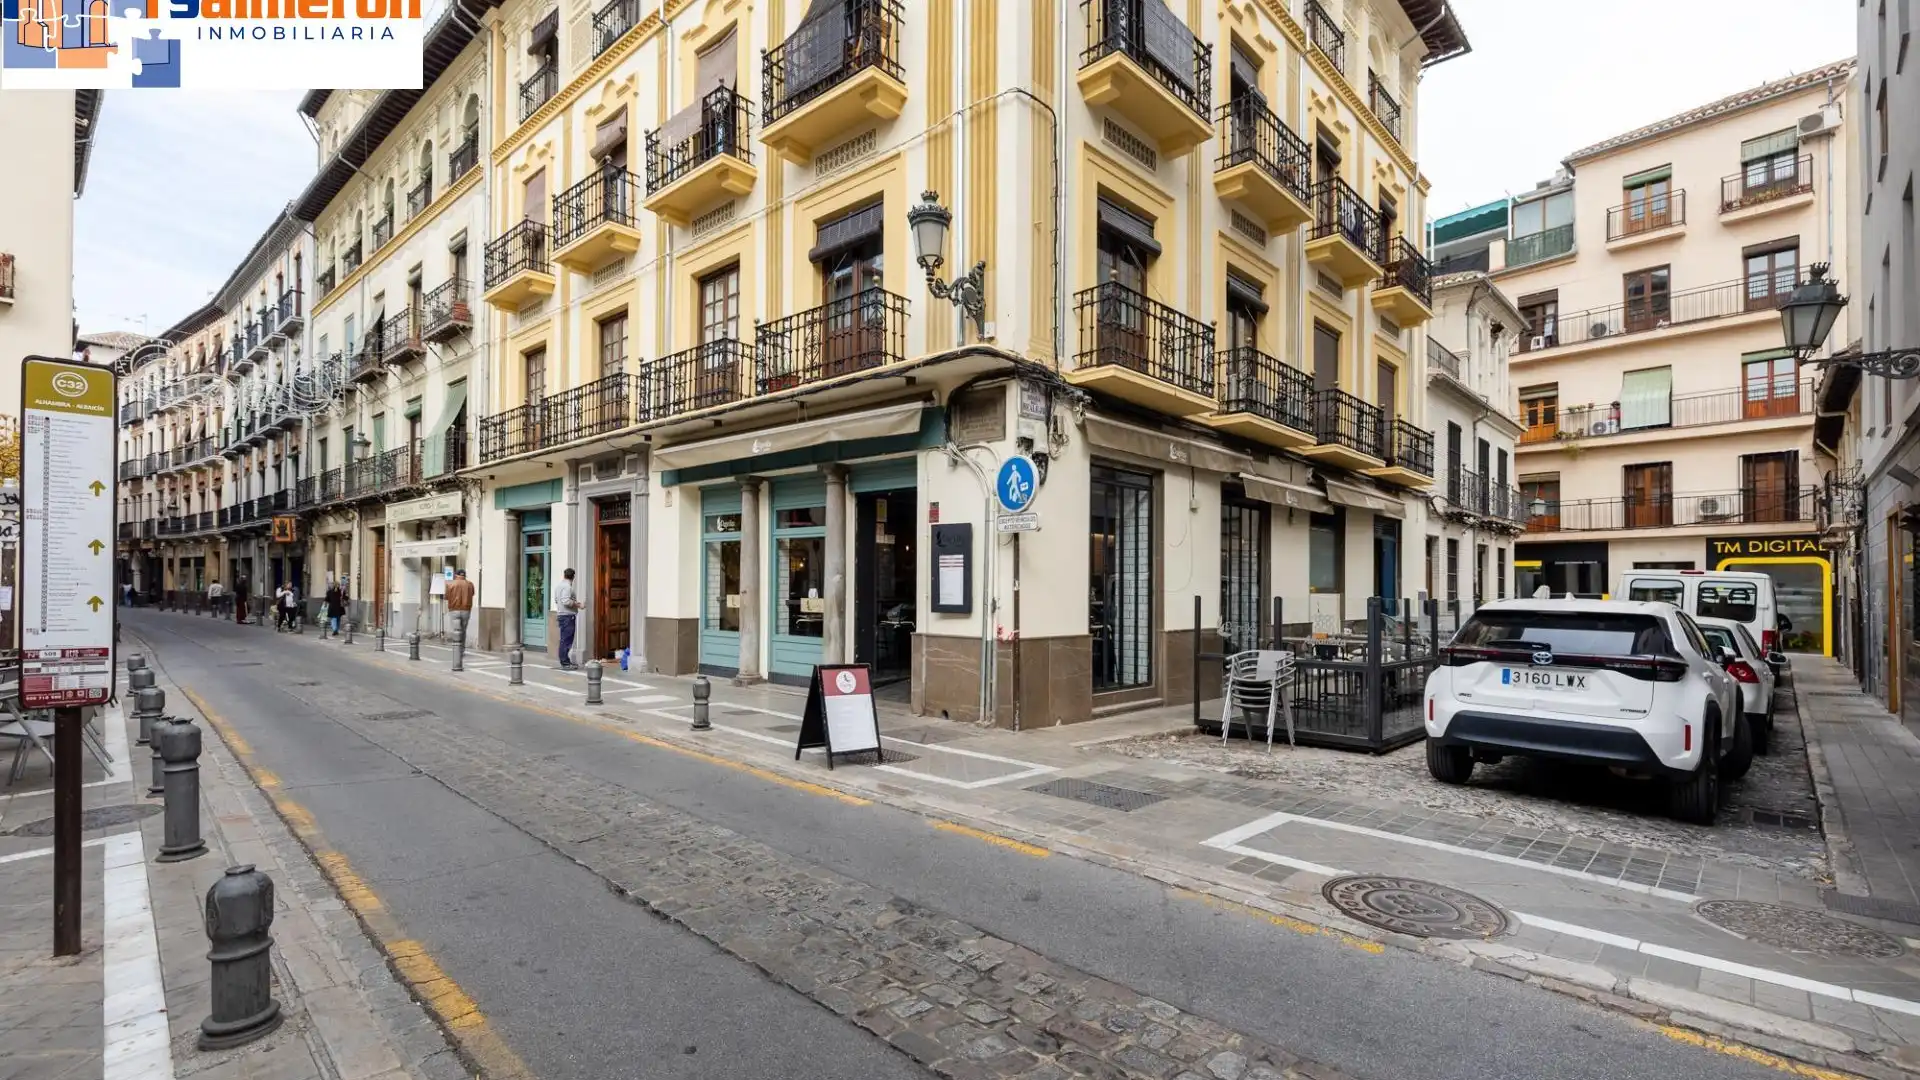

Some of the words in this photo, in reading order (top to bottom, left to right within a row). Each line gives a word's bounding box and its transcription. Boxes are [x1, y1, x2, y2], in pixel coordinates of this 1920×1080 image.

[57, 380, 84, 390] C32
[1713, 541, 1741, 553] TM
[1748, 539, 1827, 553] DIGITAL
[1513, 671, 1551, 685] 3160
[1555, 674, 1585, 688] LWX
